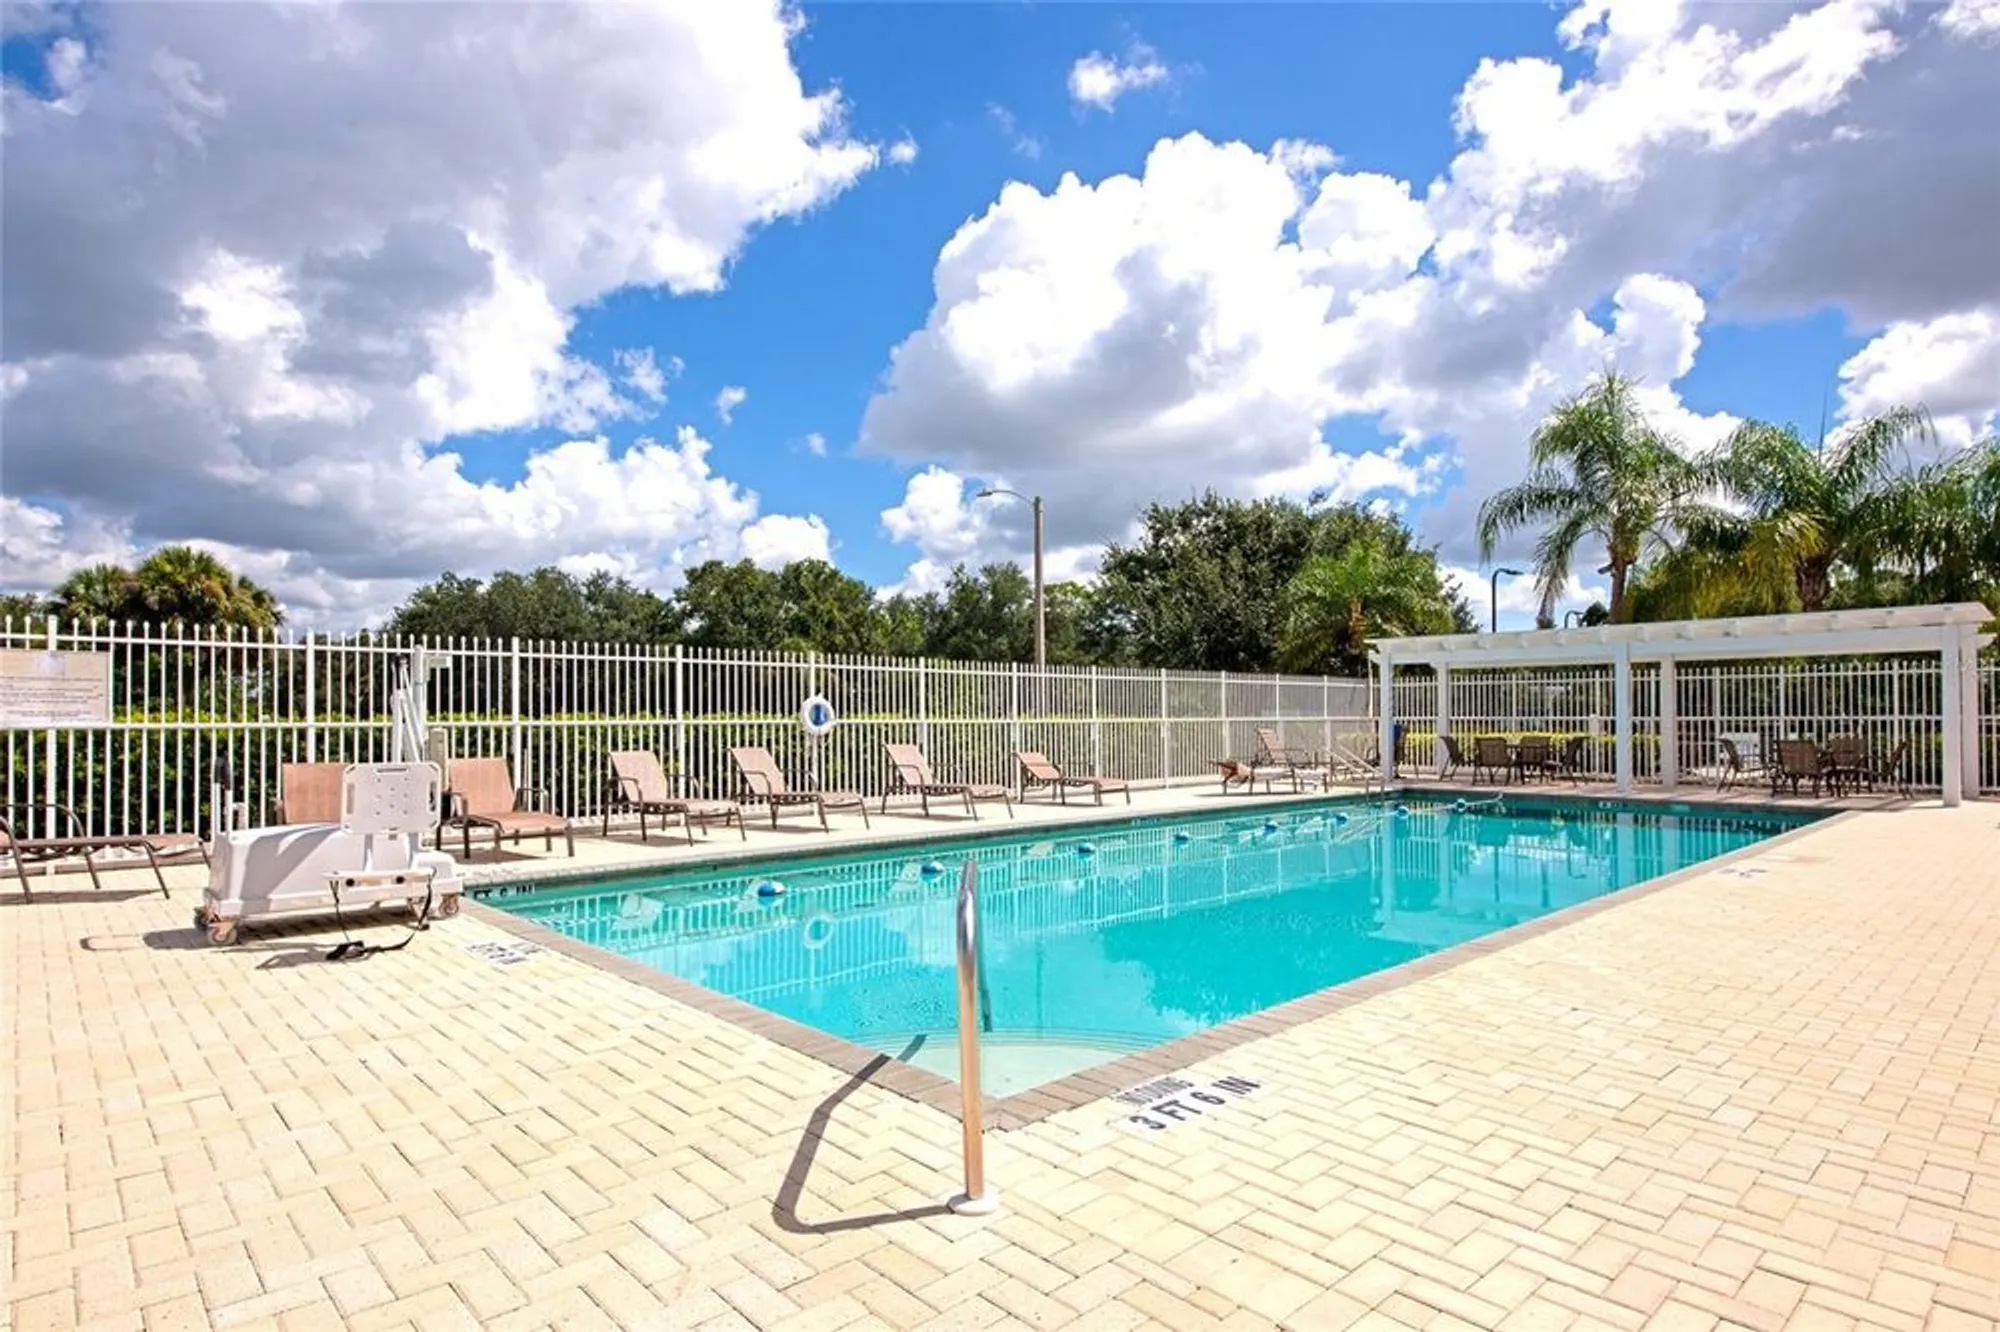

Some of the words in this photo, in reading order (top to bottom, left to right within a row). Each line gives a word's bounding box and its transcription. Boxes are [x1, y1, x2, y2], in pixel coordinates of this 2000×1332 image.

[1129, 1115, 1166, 1130] 3
[1151, 1099, 1202, 1121] FT
[1190, 1091, 1226, 1105] 6
[1211, 1076, 1261, 1095] IN
